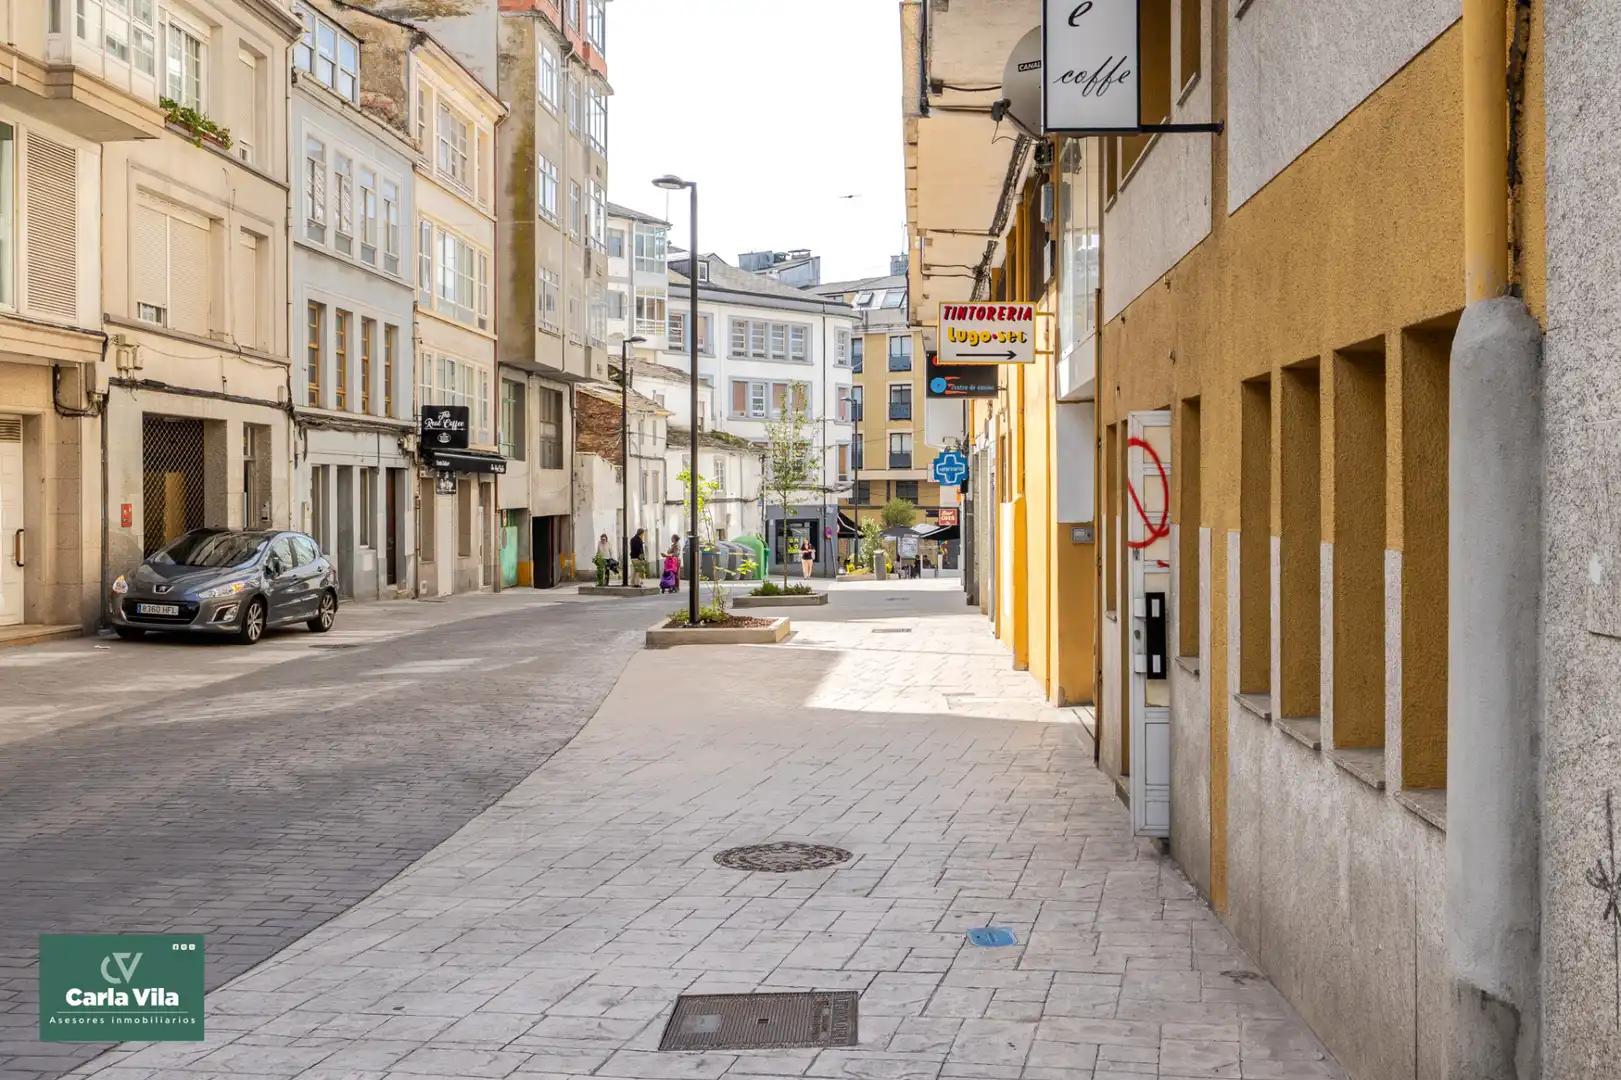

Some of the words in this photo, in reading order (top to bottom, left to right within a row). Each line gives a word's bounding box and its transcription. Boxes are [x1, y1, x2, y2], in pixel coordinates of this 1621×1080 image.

[1053, 55, 1131, 97] coffe
[943, 305, 1033, 321] TINTORERIA
[438, 411, 450, 420] The
[425, 417, 441, 428] Real
[443, 419, 464, 431] Coffee
[142, 605, 160, 613] 8360
[162, 606, 177, 615] HFL
